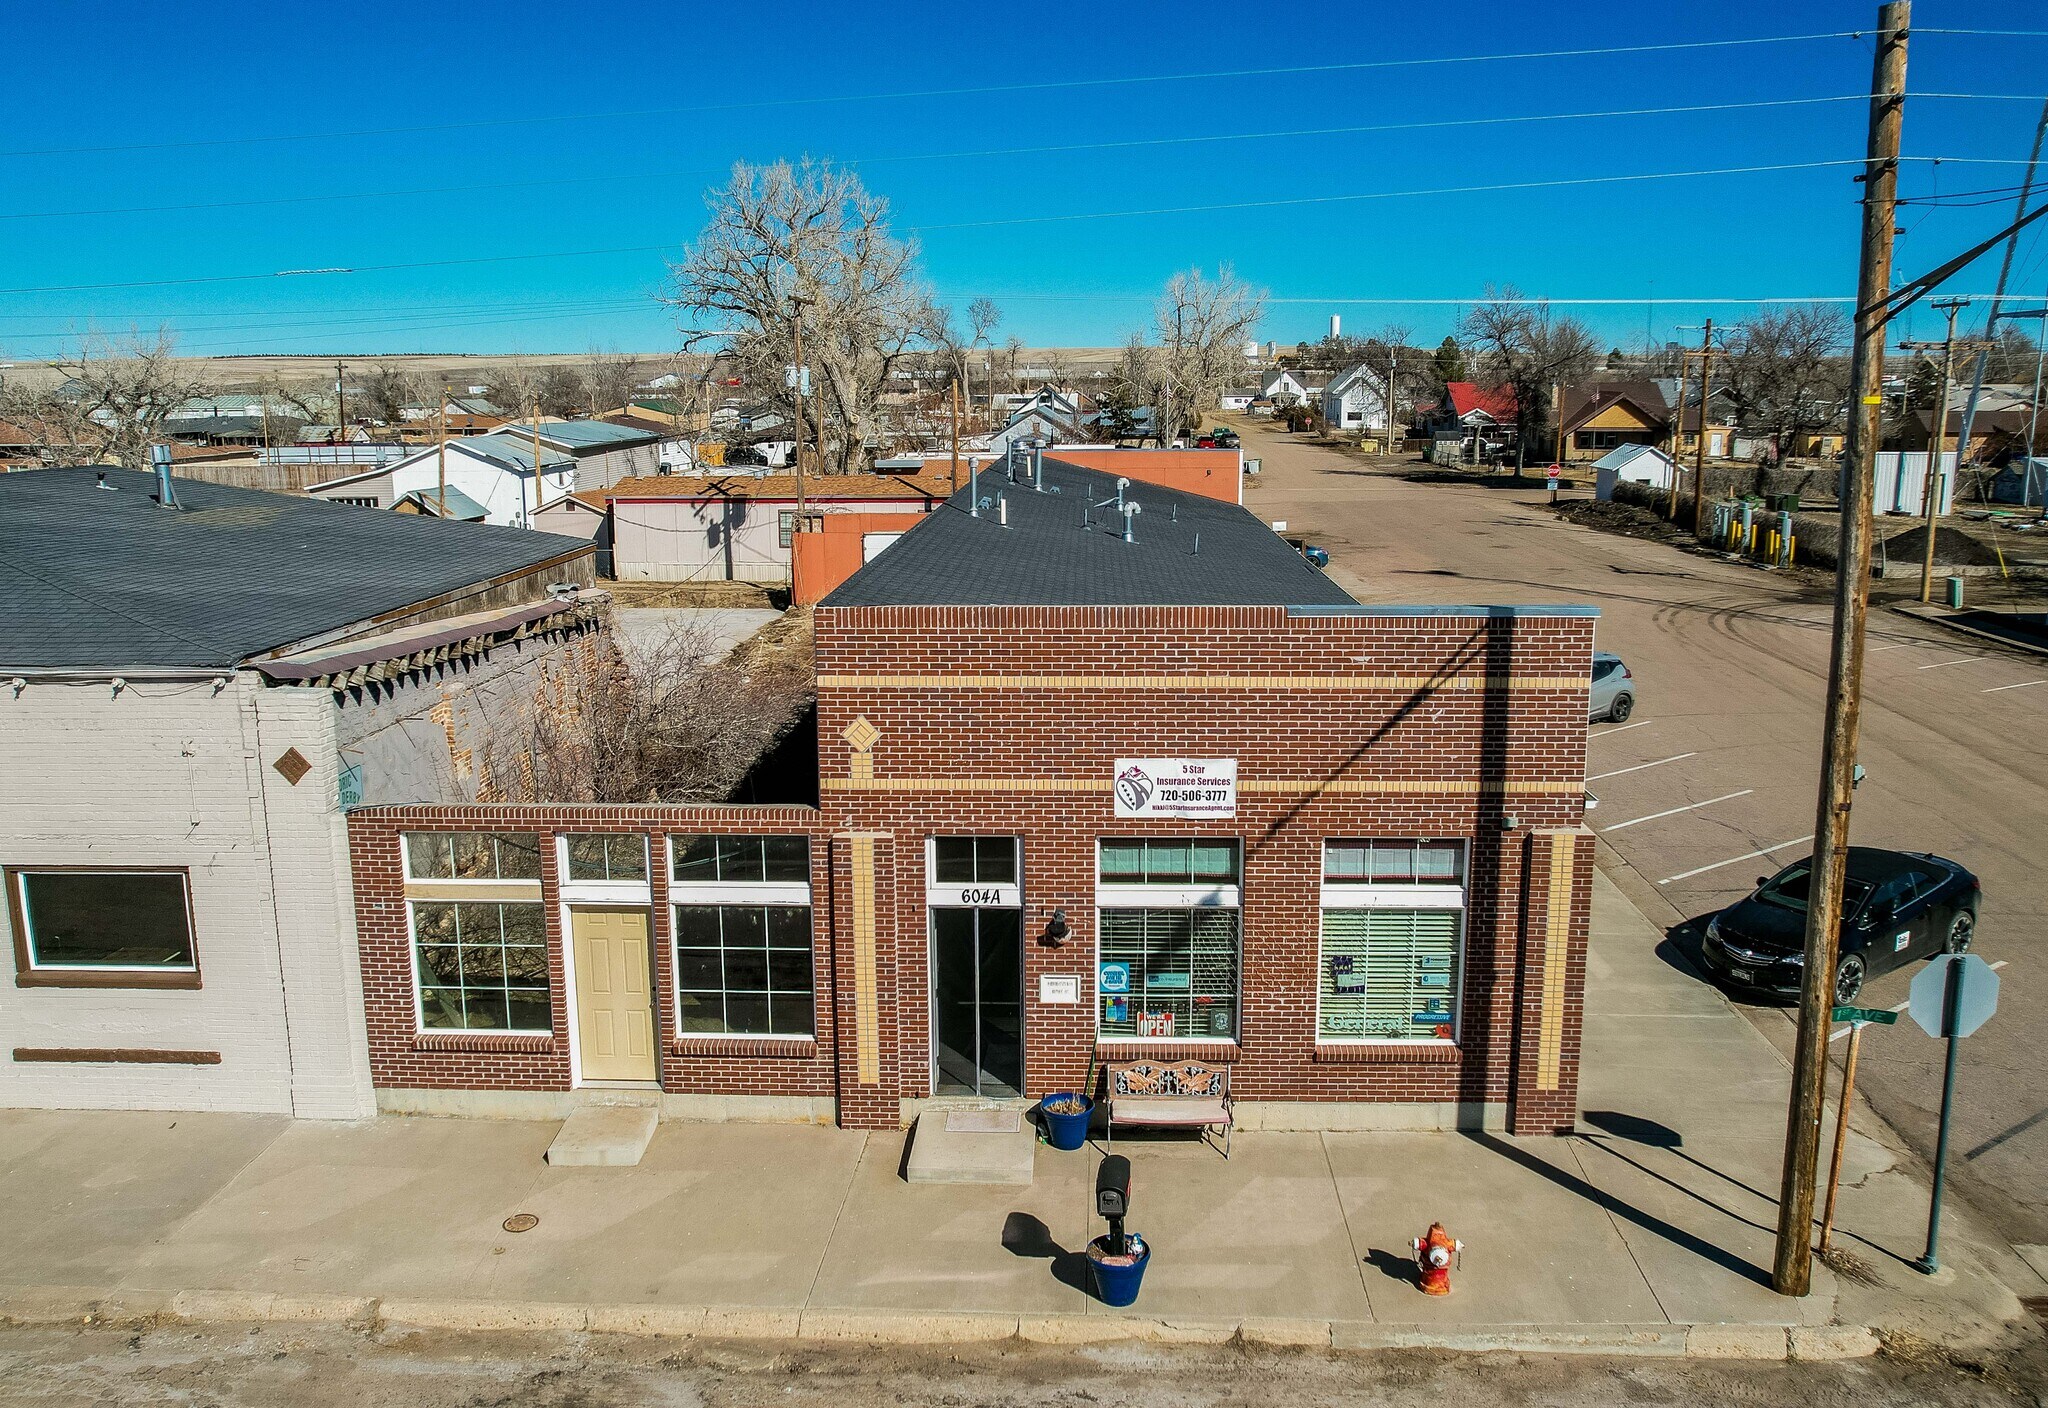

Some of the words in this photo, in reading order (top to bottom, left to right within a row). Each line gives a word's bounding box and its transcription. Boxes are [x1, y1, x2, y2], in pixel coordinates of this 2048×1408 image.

[1182, 765, 1188, 774] 5
[1189, 765, 1205, 774] Star
[1156, 777, 1196, 786] Insurance
[1197, 777, 1231, 786] Services
[342, 791, 360, 804] DERBY
[1160, 790, 1227, 801] 720-506-3777
[961, 889, 1000, 904] 604A
[1852, 1010, 1886, 1022] AVE
[1140, 1019, 1172, 1037] OPEN
